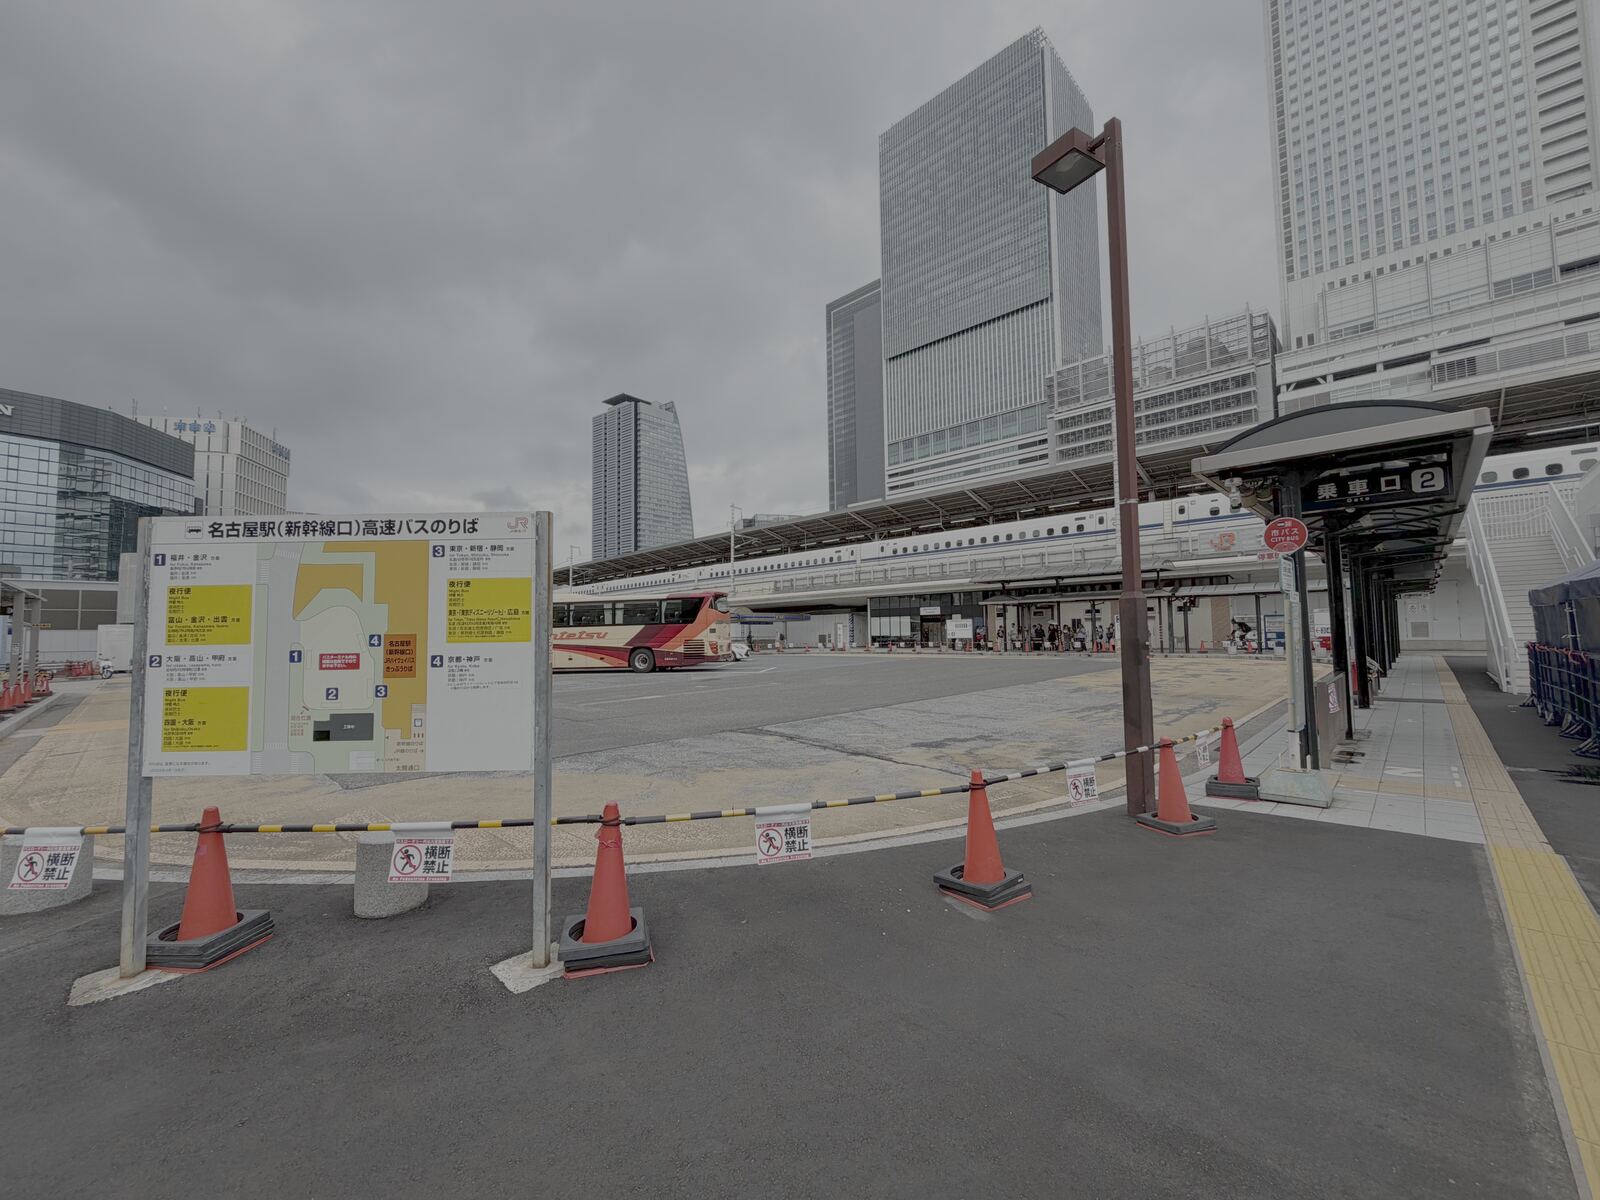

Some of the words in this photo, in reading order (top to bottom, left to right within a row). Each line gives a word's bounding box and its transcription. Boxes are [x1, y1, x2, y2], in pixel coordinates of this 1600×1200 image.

[1317, 475, 1400, 499] 乗車口
[1420, 471, 1437, 488] 2
[208, 517, 479, 539] 名古屋駅(新幹線口)高速バスのりば
[1270, 528, 1300, 537] 市バス
[150, 656, 161, 666] 2
[784, 826, 808, 840] 横断
[424, 845, 451, 860] 横断
[784, 839, 809, 853] 禁止
[46, 852, 76, 867] 横断
[42, 866, 71, 881] 禁止
[422, 860, 449, 874] 禁止
